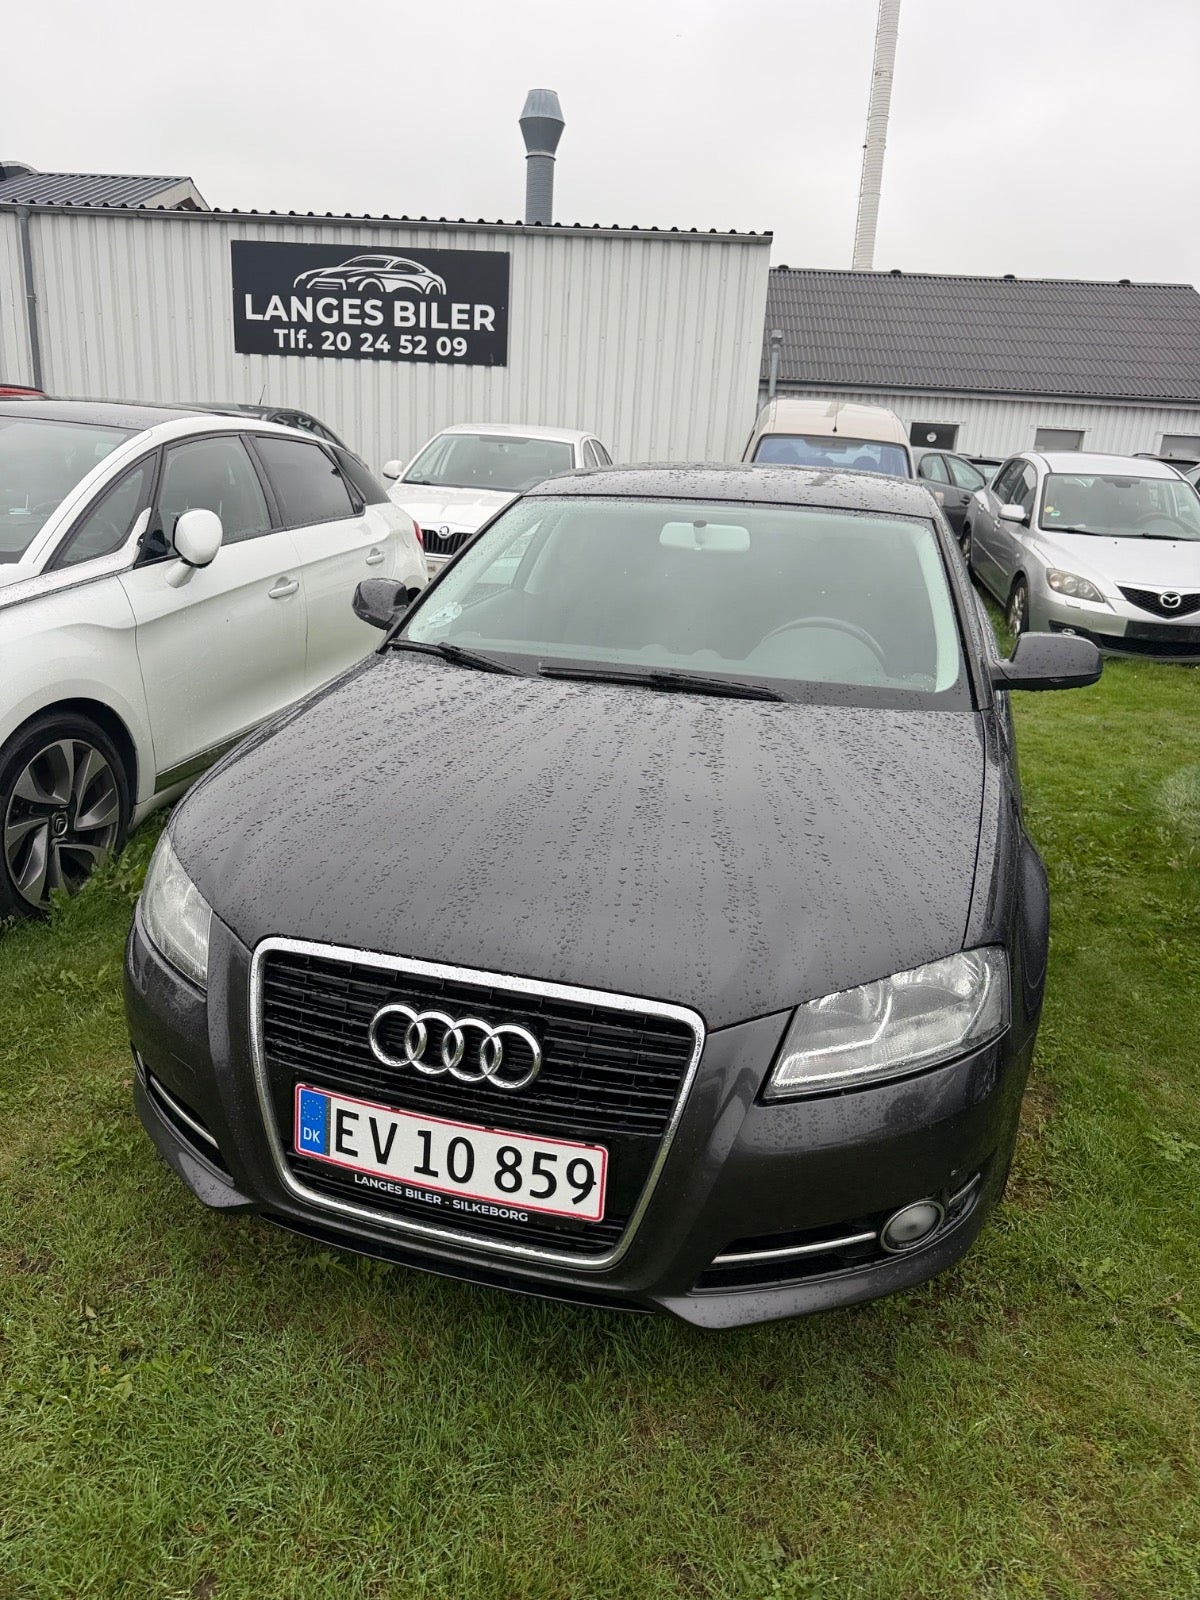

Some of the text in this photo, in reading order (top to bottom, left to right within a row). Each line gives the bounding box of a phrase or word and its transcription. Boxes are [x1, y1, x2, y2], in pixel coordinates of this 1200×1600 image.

[245, 293, 496, 332] LANGES BILER
[273, 328, 468, 357] Tlf. 20 24 52 09
[303, 1126, 321, 1144] DK
[335, 1107, 597, 1205] EV 10 859
[354, 1173, 402, 1195] LANGES
[405, 1188, 442, 1205] BILER
[452, 1199, 529, 1223] SILKEBORG
